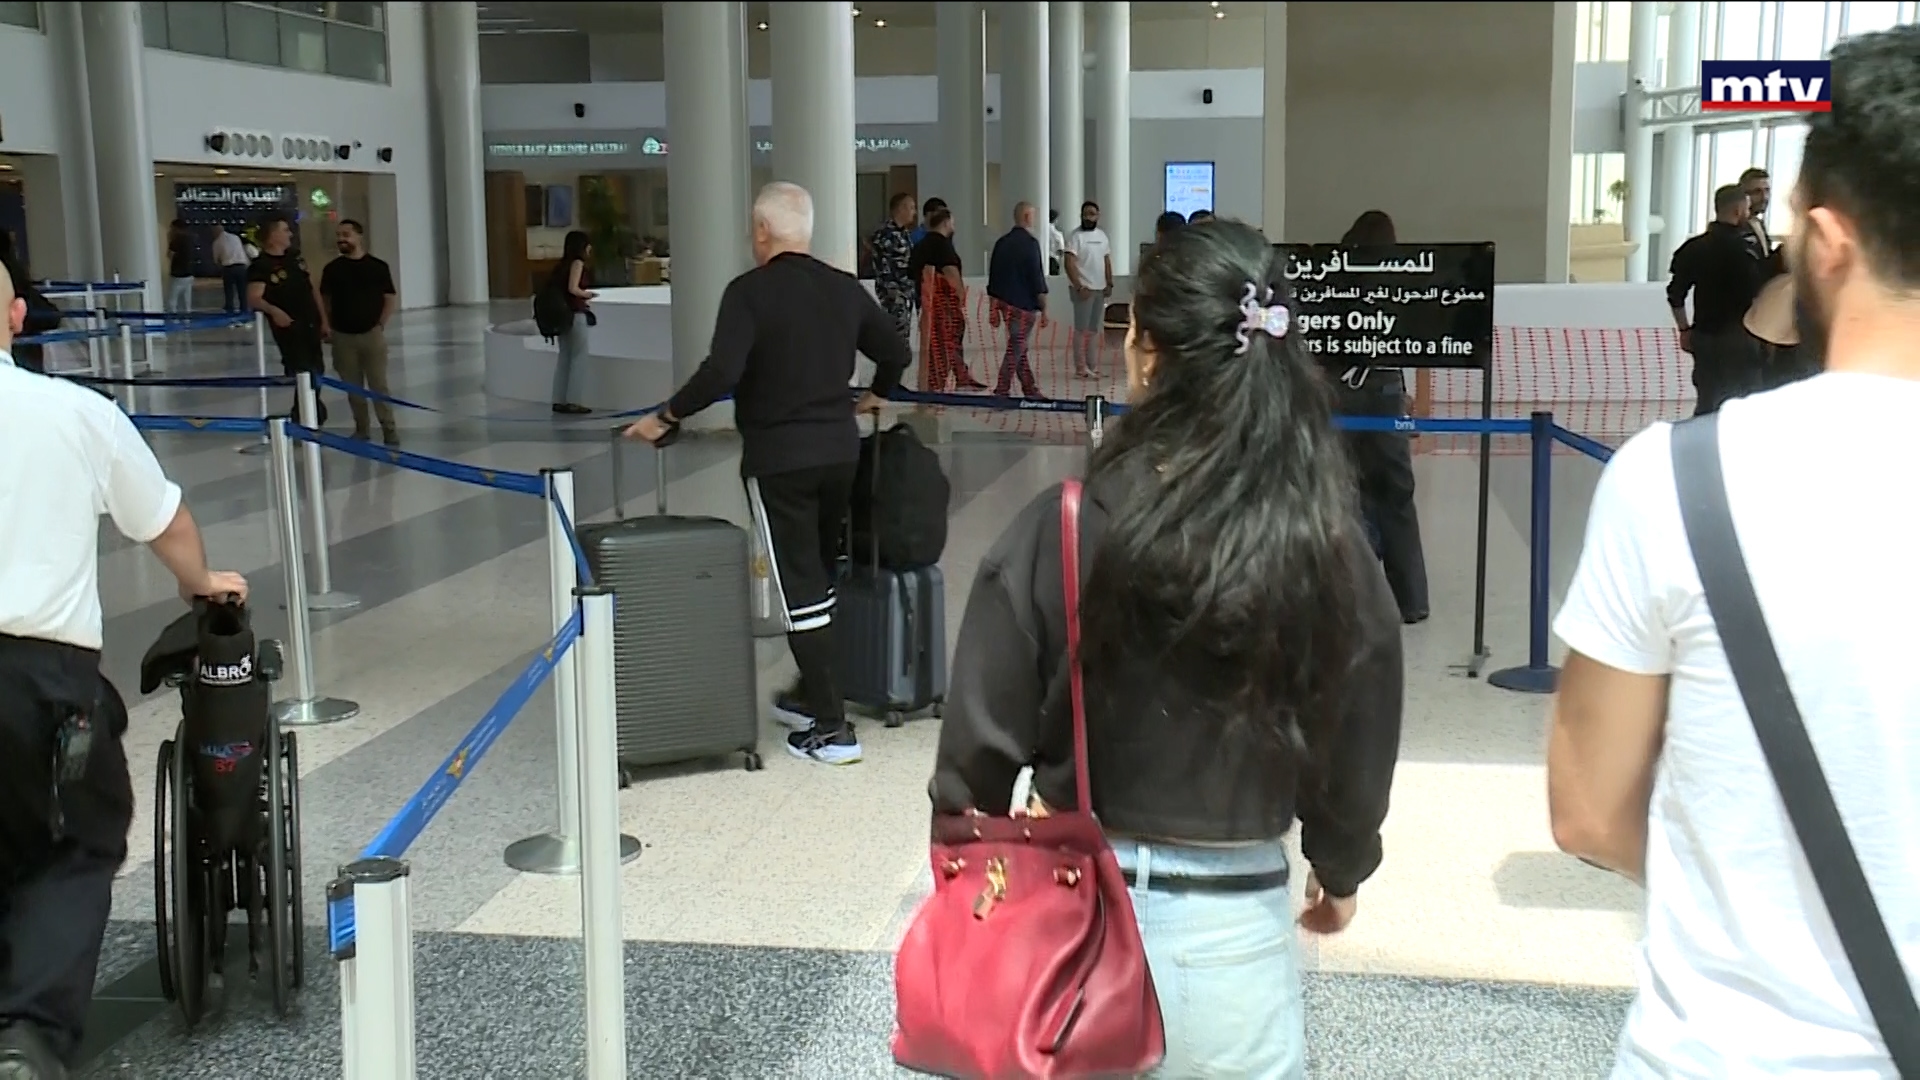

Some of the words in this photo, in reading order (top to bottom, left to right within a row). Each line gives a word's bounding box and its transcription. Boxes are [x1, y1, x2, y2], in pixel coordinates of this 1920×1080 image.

[1284, 249, 1434, 280] للمسافرين
[1300, 285, 1360, 303] المسافرين
[1362, 286, 1389, 304] لغير
[1440, 286, 1485, 305] ممنوع
[1298, 314, 1341, 334] gers
[1347, 310, 1396, 334] Only
[1327, 335, 1340, 353] is
[1344, 335, 1401, 358] subject
[1405, 338, 1422, 354] to
[1426, 340, 1437, 354] a
[1441, 336, 1473, 355] fine
